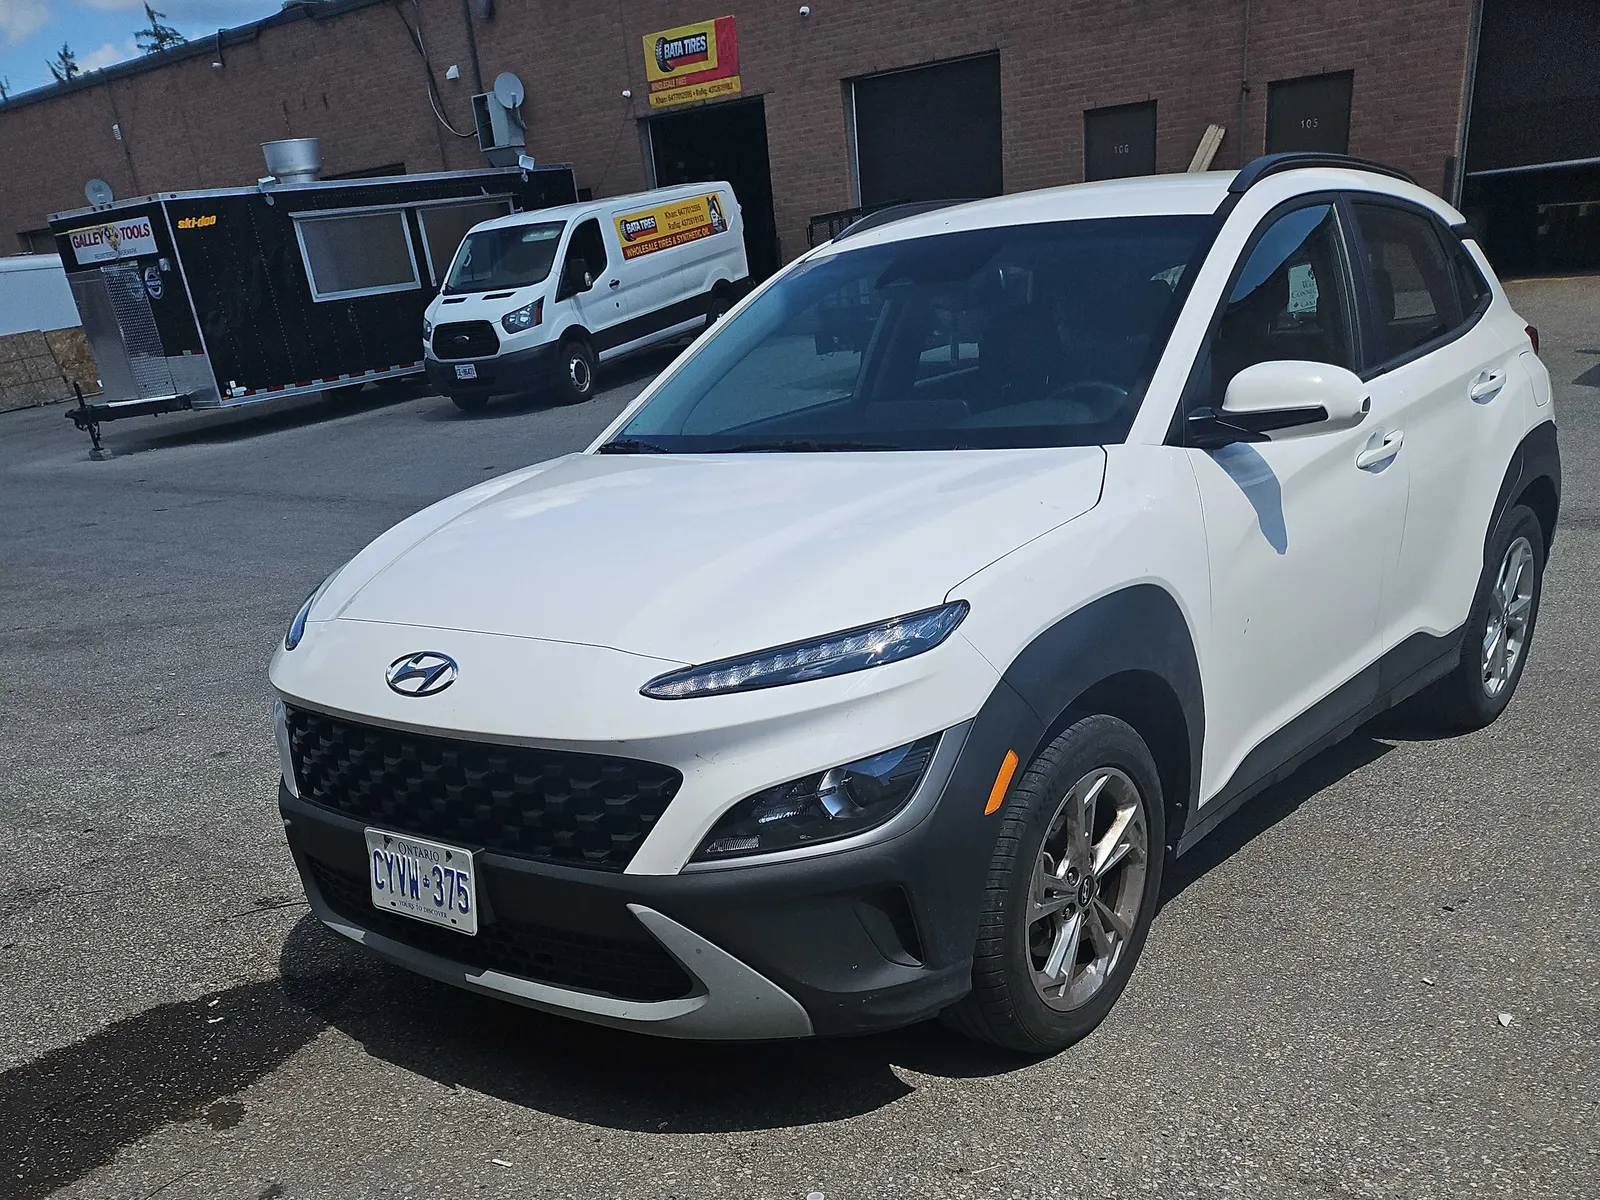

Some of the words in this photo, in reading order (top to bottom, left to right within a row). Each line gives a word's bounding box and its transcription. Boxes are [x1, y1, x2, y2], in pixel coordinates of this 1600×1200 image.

[663, 41, 684, 59] BATA
[684, 35, 706, 54] TIRES
[1300, 118, 1318, 129] 105
[1113, 144, 1130, 155] 106
[177, 215, 216, 229] ski-doo
[625, 220, 641, 234] BATA
[641, 217, 656, 230] TIRES
[72, 231, 105, 249] GALLEY
[120, 223, 151, 241] TOOLS
[626, 241, 658, 257] WHOLESALE
[658, 238, 672, 249] TIRES
[676, 229, 701, 244] SYNTHETIC
[701, 227, 710, 237] OIL
[397, 841, 440, 863] ONTARIO
[373, 848, 421, 901] CYVW
[431, 864, 471, 915] 375
[415, 903, 423, 912] TO
[423, 906, 448, 919] DISCOVER
